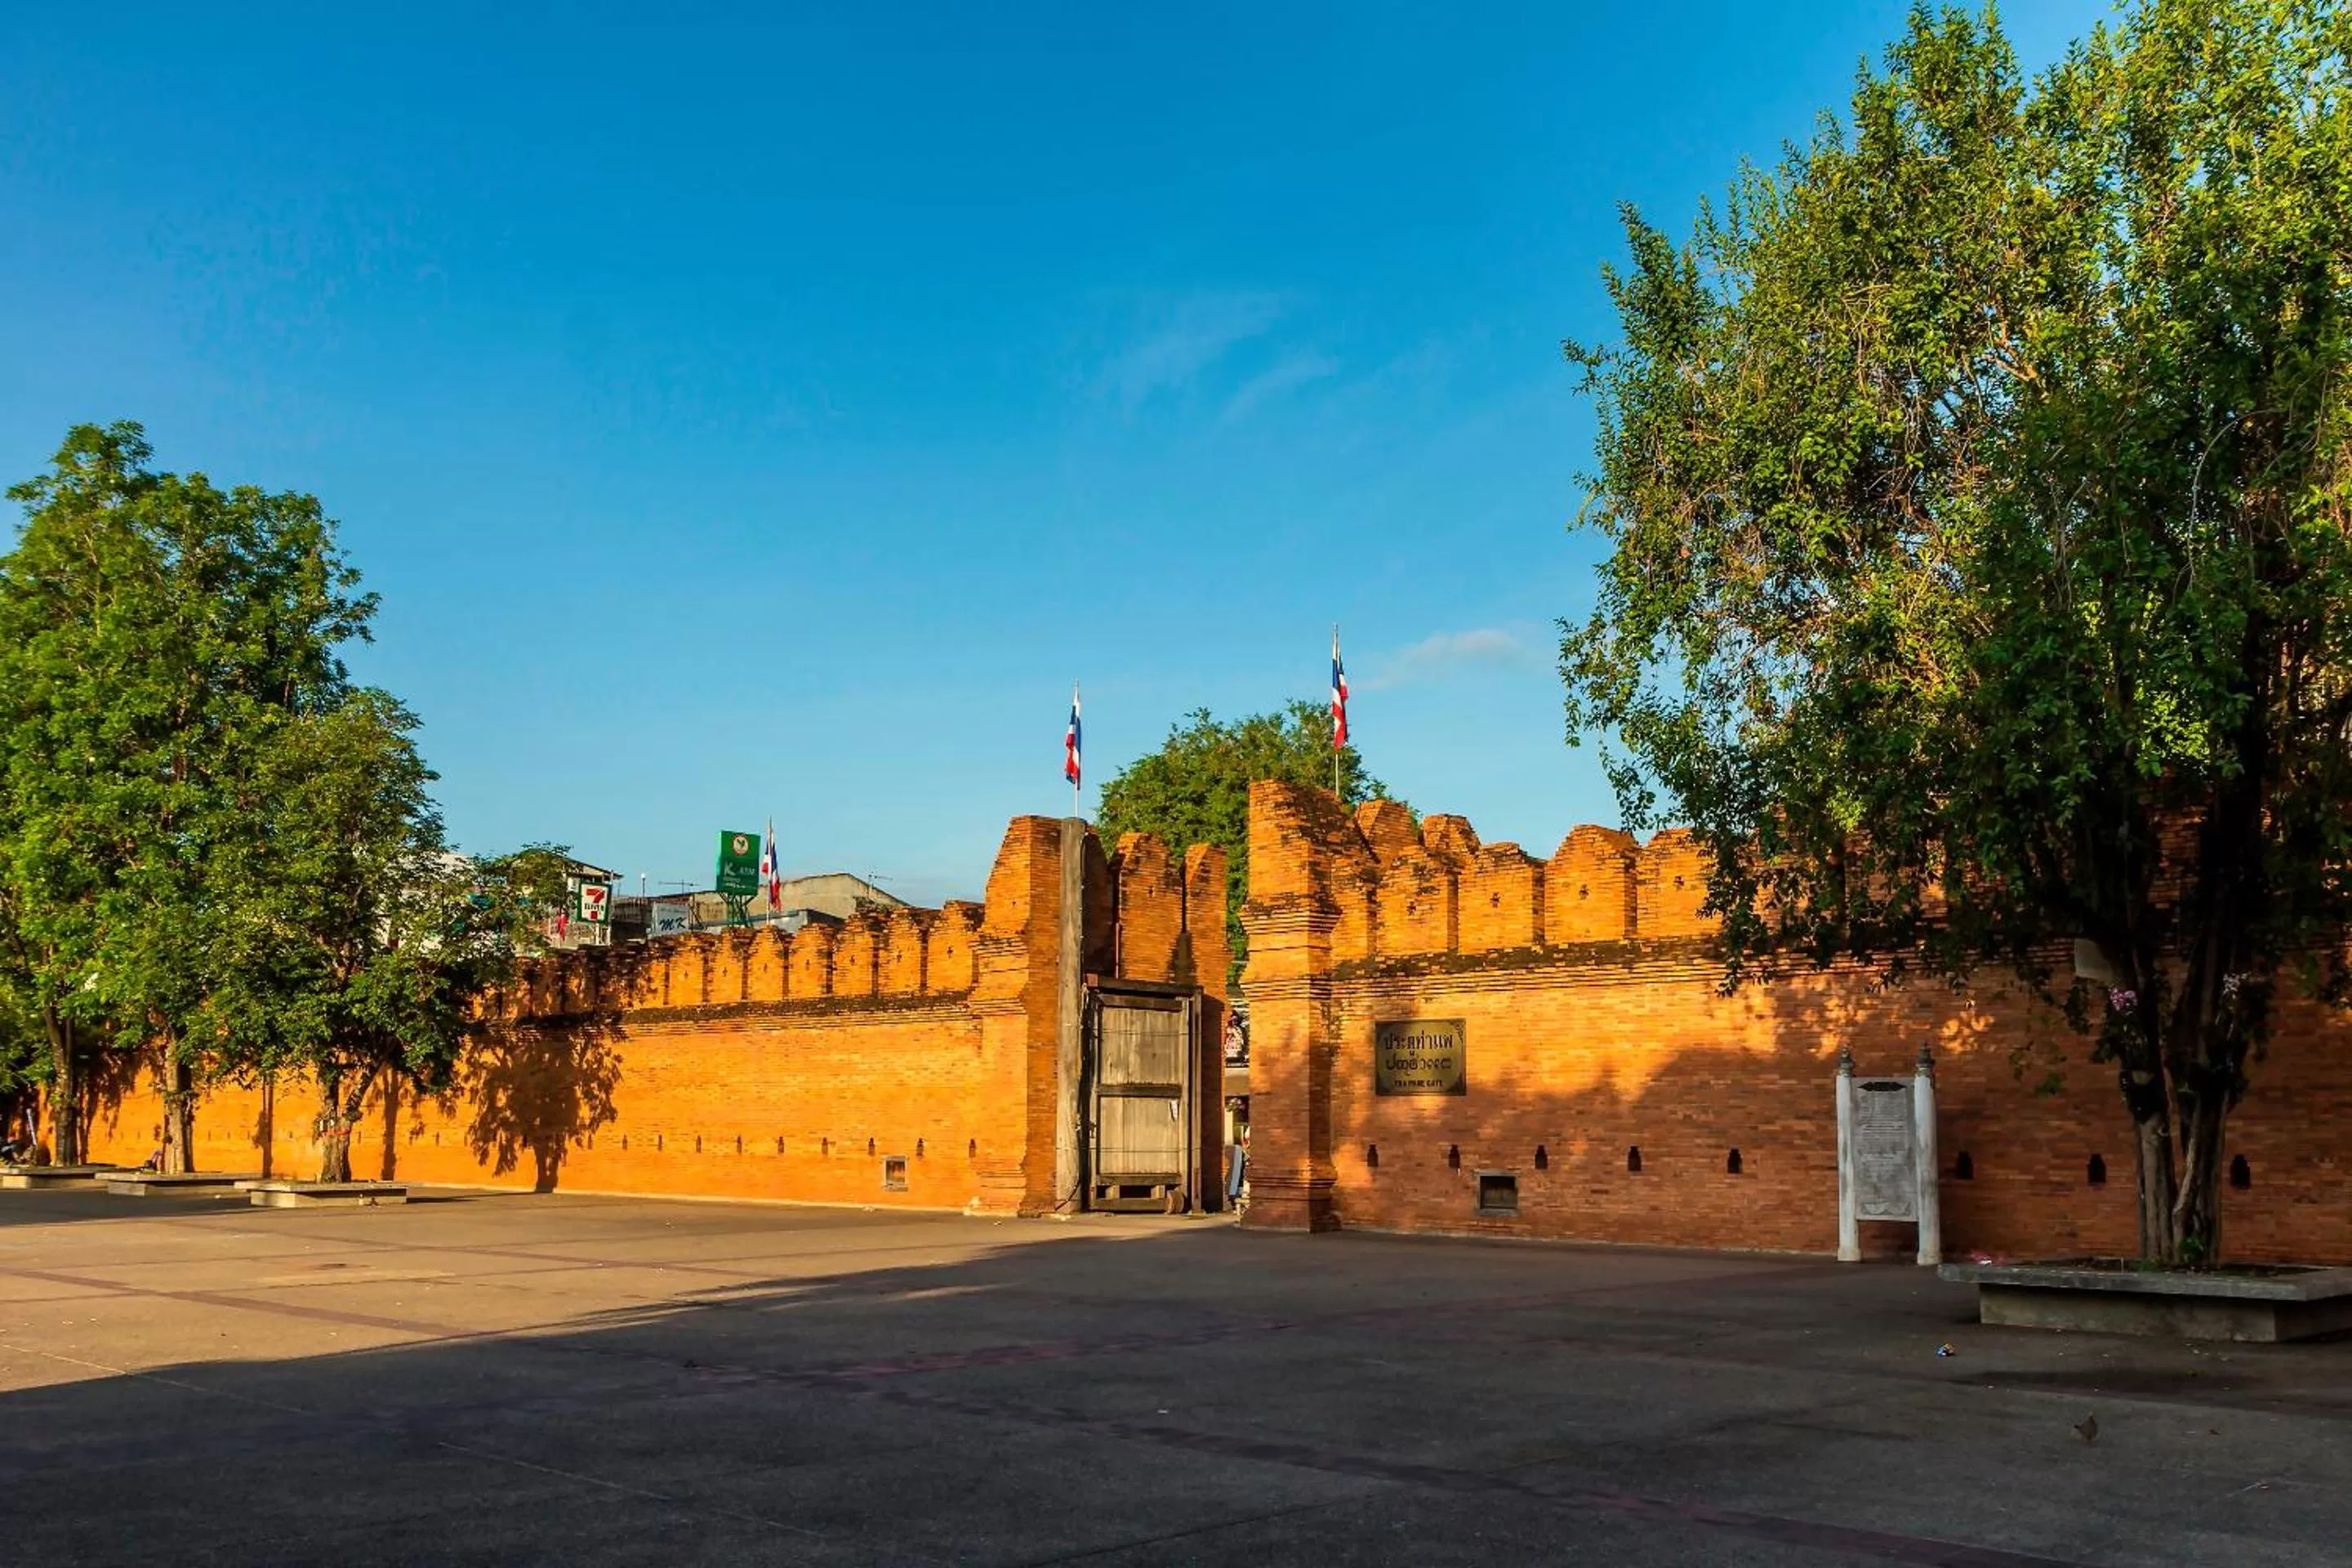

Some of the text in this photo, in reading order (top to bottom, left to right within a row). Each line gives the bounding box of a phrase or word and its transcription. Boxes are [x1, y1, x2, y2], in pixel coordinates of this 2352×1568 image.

[724, 862, 737, 876] K
[1384, 1030, 1453, 1056] ประตูท่าแพ
